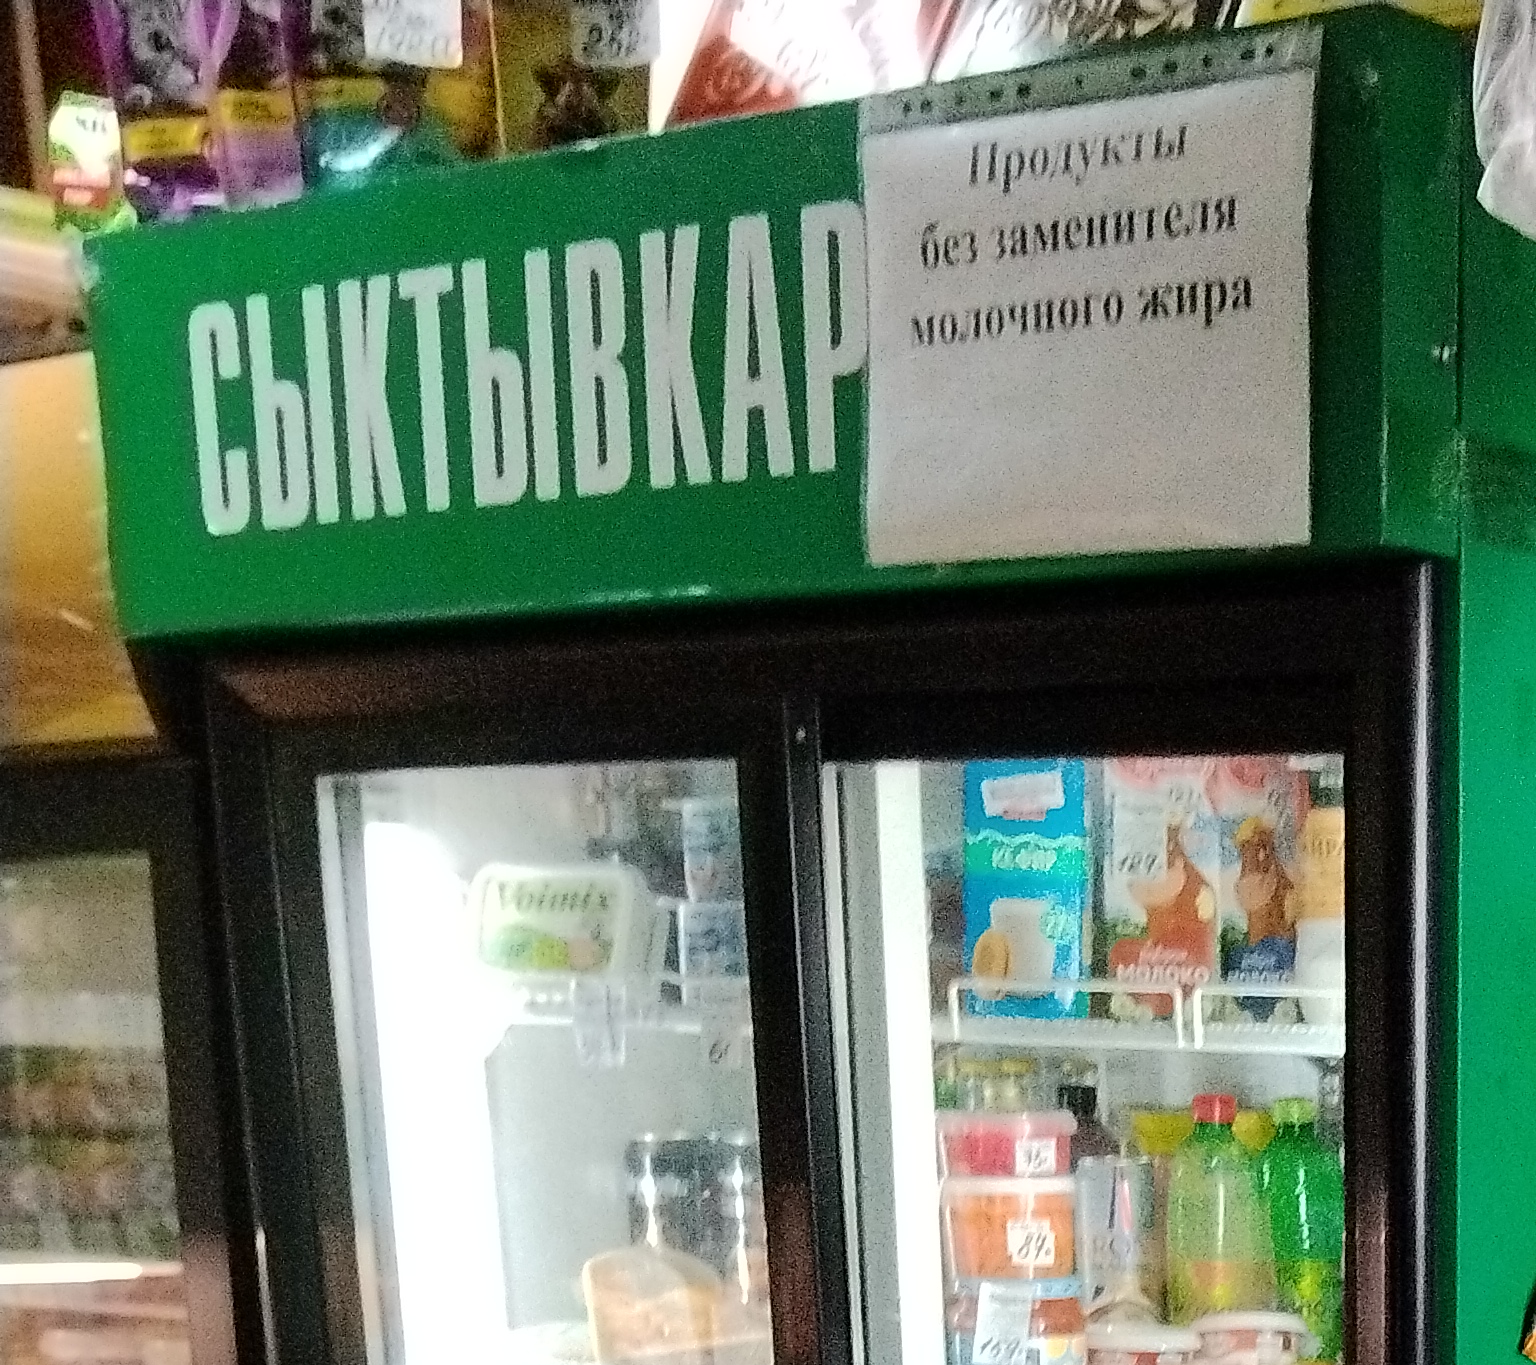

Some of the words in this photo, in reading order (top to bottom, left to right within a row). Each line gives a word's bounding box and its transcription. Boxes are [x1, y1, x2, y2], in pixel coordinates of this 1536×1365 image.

[968, 125, 1188, 193] Продукты
[919, 222, 979, 270] без
[991, 195, 1238, 261] заменителя
[909, 289, 1124, 348] молочного
[1137, 272, 1253, 328] жира
[188, 200, 866, 536] СЫКТЫВКАР
